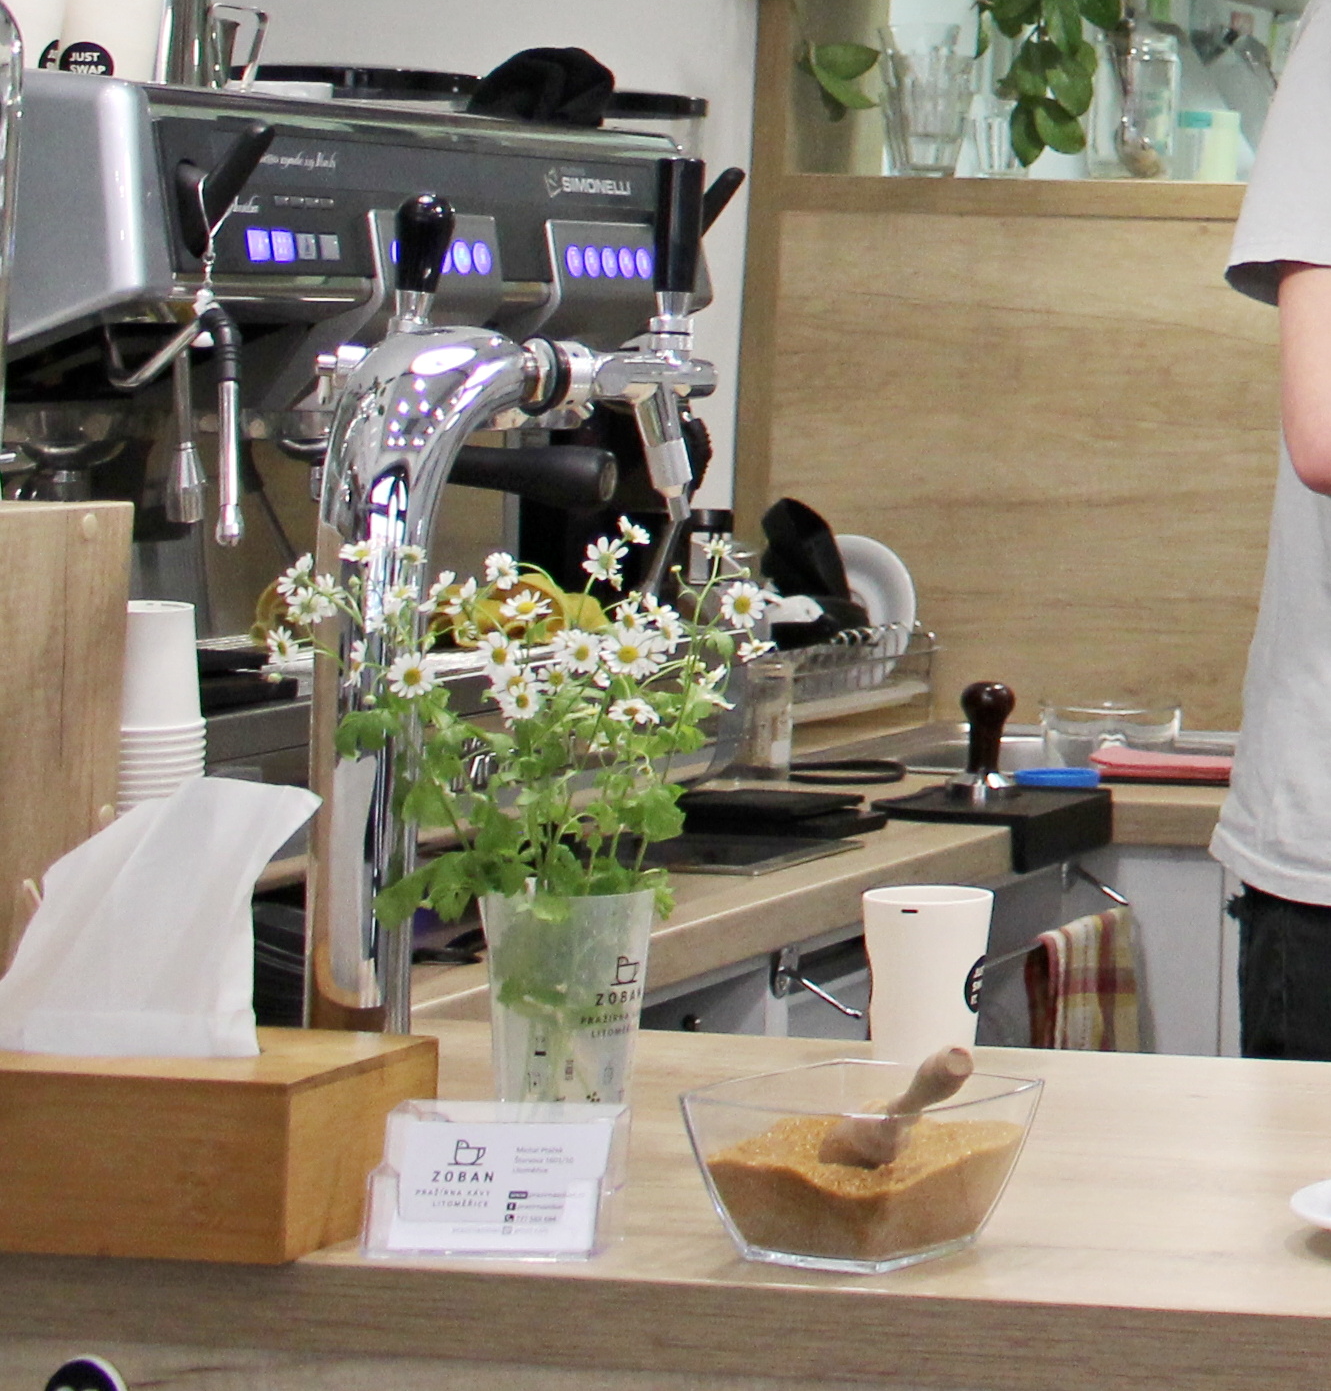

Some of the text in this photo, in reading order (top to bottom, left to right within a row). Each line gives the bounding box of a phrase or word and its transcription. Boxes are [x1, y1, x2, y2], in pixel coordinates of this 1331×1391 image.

[69, 51, 101, 63] JUST
[560, 176, 632, 197] SIMONELLI
[431, 1170, 495, 1184] ZOBAN
